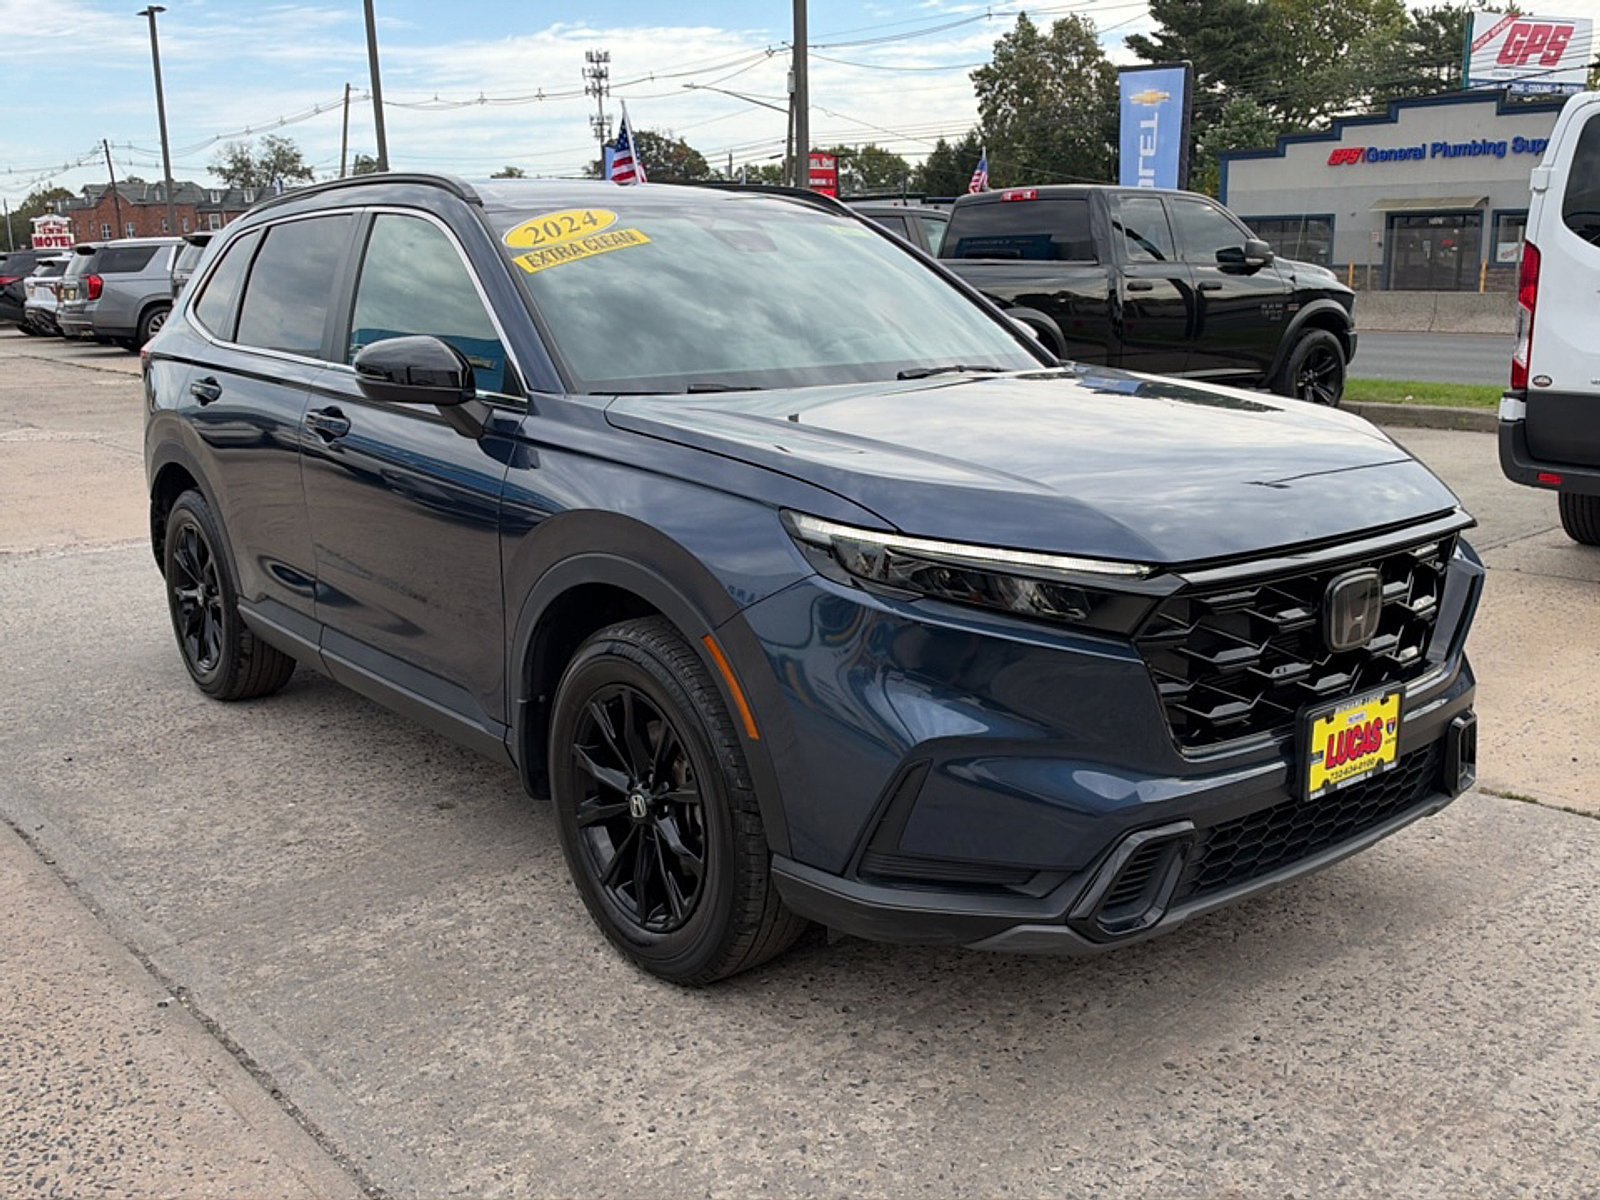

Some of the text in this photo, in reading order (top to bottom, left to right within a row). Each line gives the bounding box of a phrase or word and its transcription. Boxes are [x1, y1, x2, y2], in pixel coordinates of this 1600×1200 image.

[1496, 23, 1575, 67] GPS
[1328, 148, 1363, 166] GPS
[1367, 144, 1426, 163] General
[1431, 138, 1508, 159] Plumbing
[33, 236, 74, 248] MOTEL
[524, 211, 598, 245] 2024
[524, 231, 637, 268] EXTRA CLEAN
[1325, 716, 1383, 770] LUCAS
